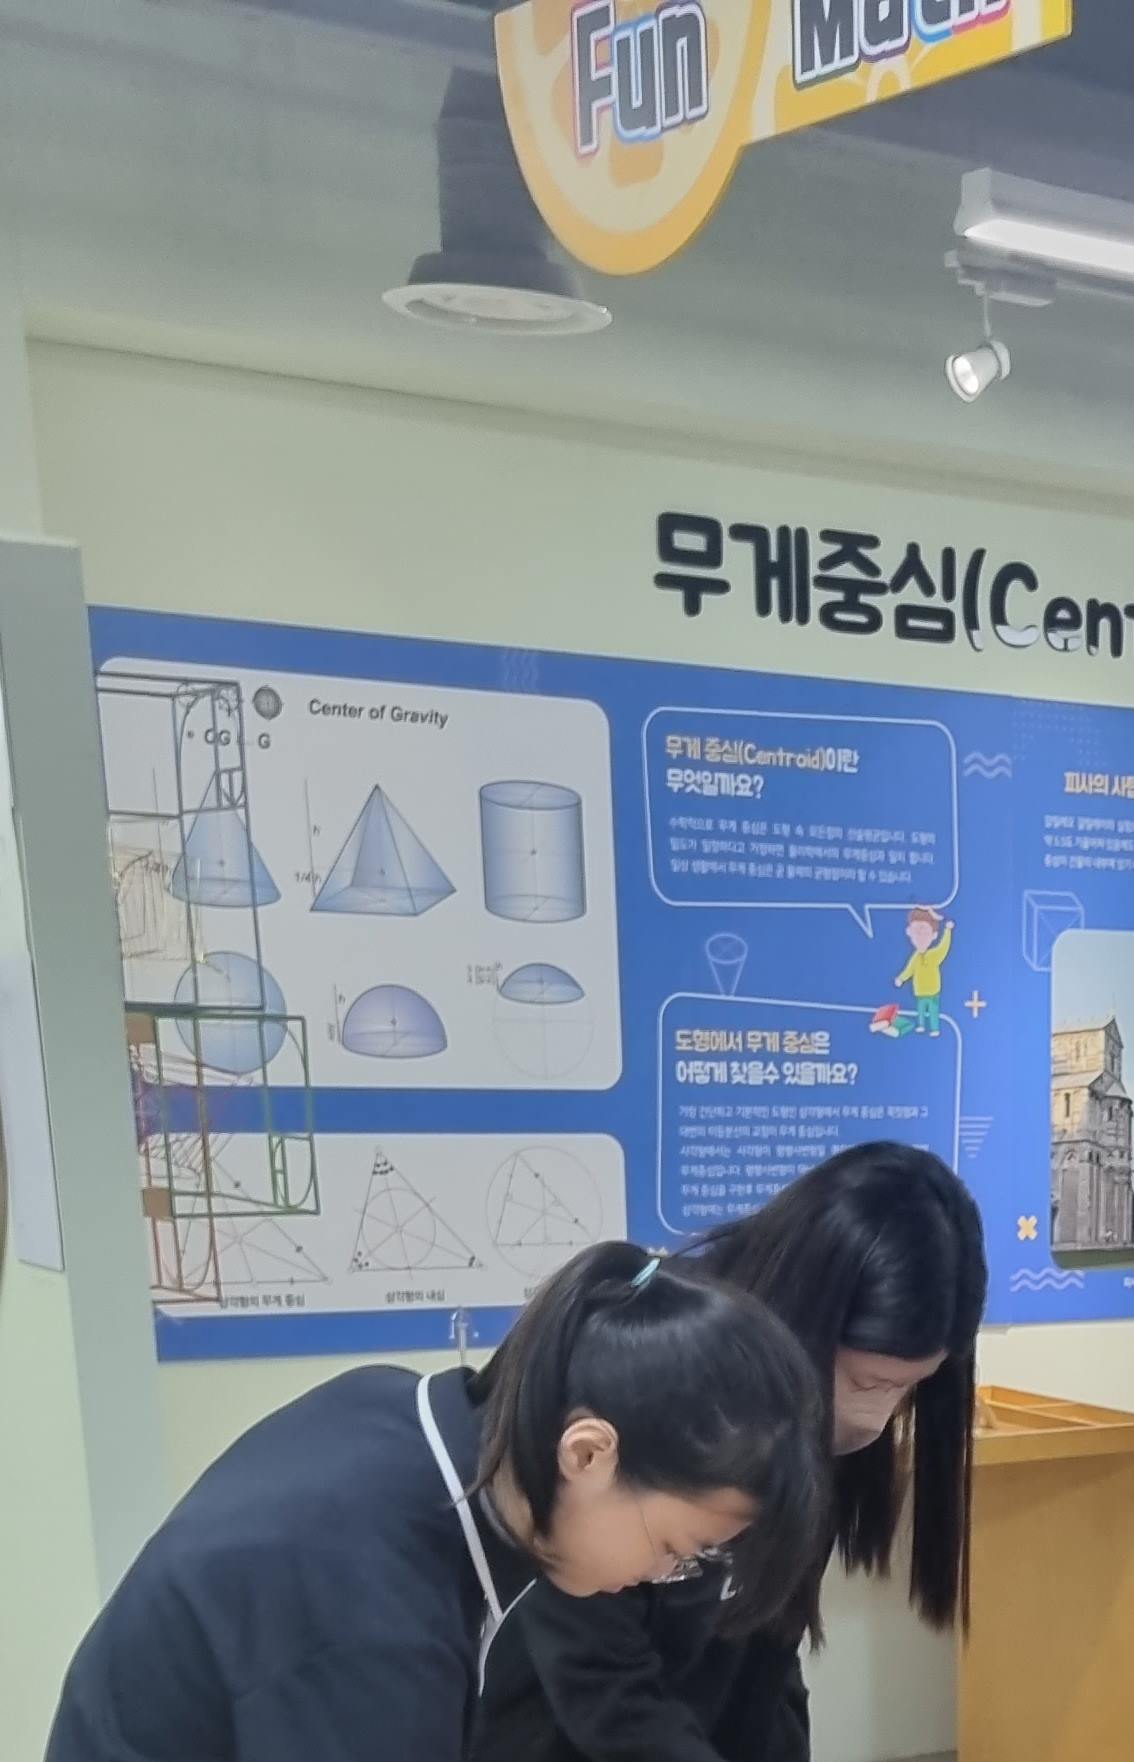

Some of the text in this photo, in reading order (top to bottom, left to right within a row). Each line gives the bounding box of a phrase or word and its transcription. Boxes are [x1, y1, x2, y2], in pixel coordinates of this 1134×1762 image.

[572, 3, 708, 156] Fun
[309, 698, 449, 730] Center of Gravity
[665, 735, 701, 760] 무게
[666, 768, 765, 799] 무엇일까요?
[1063, 770, 1109, 796] 피사의
[675, 1029, 830, 1055] 도형에서 무게 중심은
[675, 1060, 728, 1085] 어떻게
[782, 1061, 858, 1086] 있을까요?
